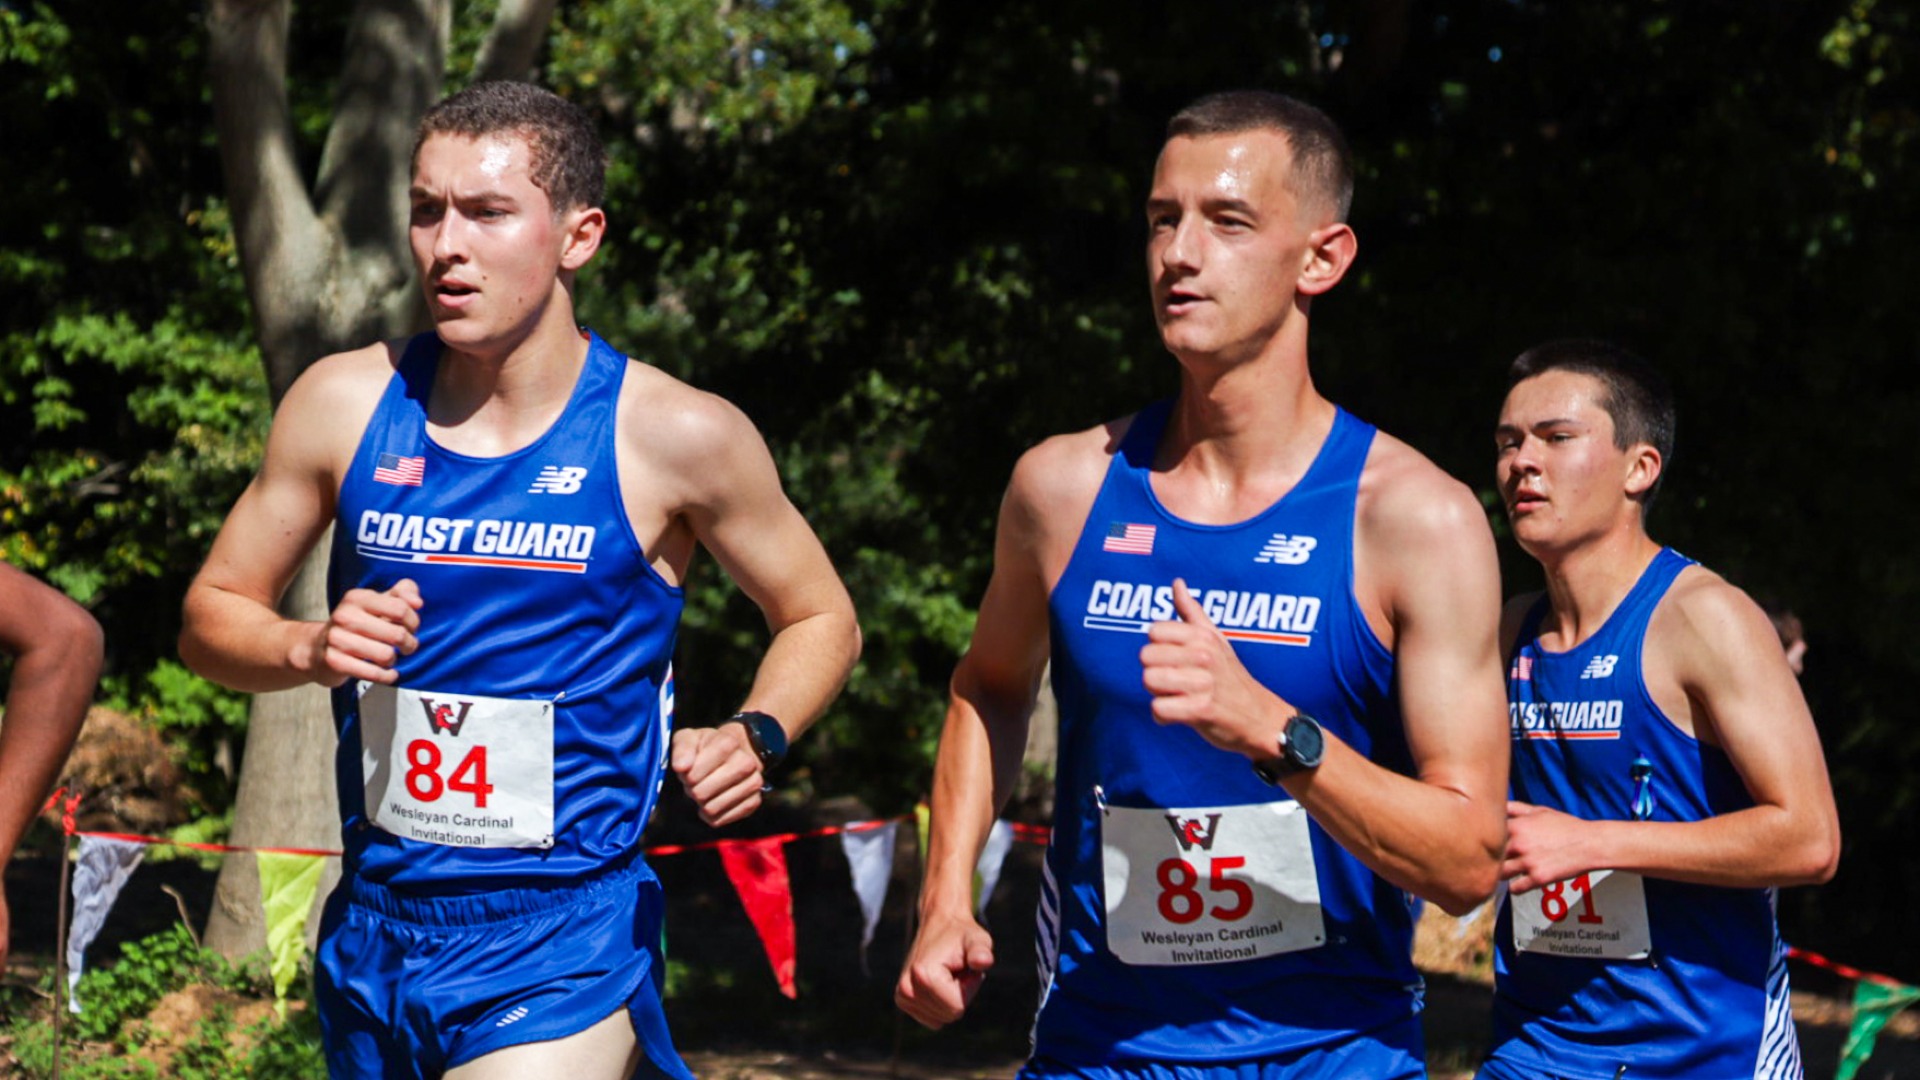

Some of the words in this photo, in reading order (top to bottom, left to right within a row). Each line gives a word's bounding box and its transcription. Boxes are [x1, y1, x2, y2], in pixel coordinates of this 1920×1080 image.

[357, 510, 472, 552] COAST
[473, 520, 595, 560] GUARD
[1204, 590, 1321, 632] GUARD
[1550, 700, 1624, 729] GUARD
[405, 739, 493, 808] 84
[389, 802, 449, 825] Wesleyan
[452, 813, 514, 829] Cardinal
[411, 826, 486, 846] Invitational
[1156, 856, 1254, 924] 85
[1541, 873, 1603, 924] 81
[1141, 929, 1215, 948] Wesleyan
[1218, 921, 1284, 942] Cardinal
[1549, 942, 1603, 955] Invitational
[1577, 928, 1620, 941] Cardinal
[1172, 944, 1258, 963] Invitational
